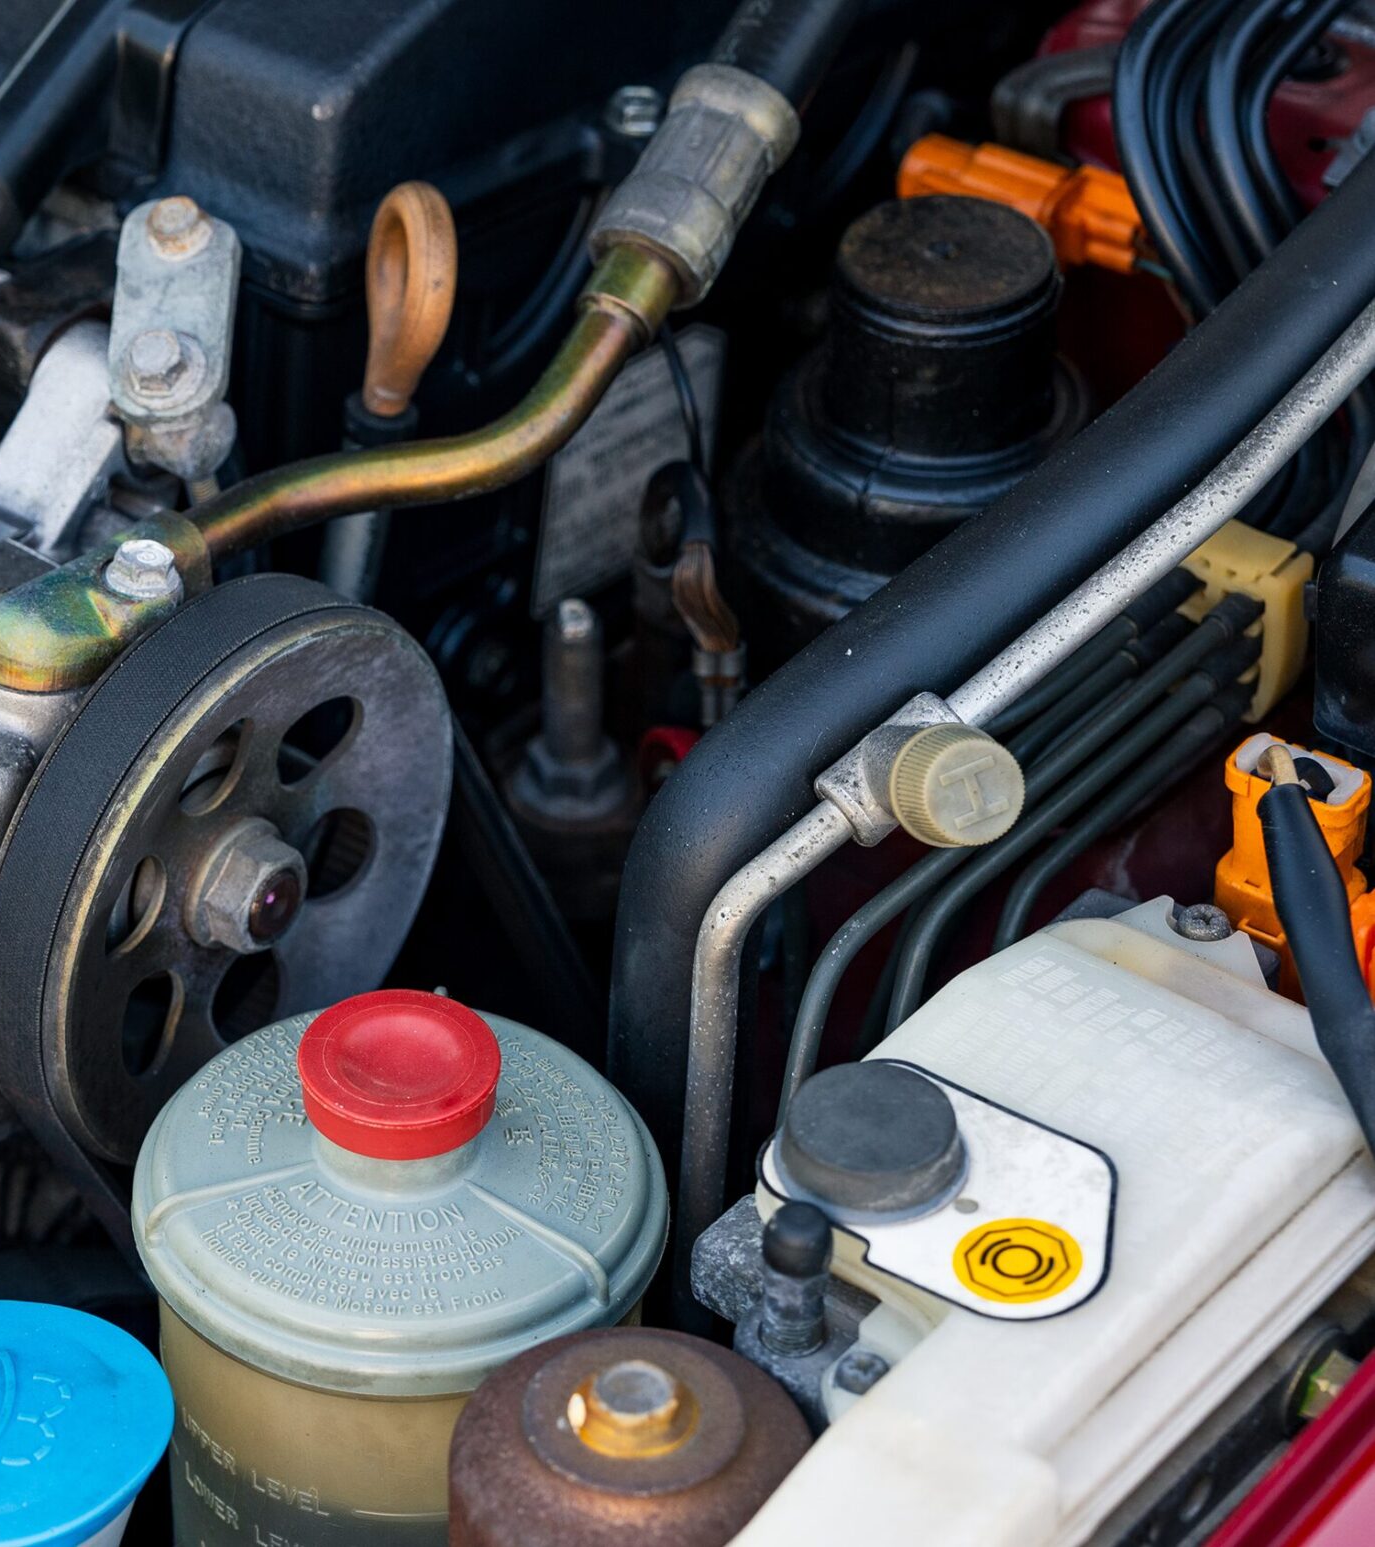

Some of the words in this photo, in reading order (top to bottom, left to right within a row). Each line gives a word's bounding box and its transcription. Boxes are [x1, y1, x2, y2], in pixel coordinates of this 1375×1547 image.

[939, 755, 1010, 830] H
[243, 1192, 283, 1232] liquide
[281, 1226, 302, 1243] de
[302, 1237, 380, 1267] direction
[379, 1249, 461, 1269] assistee
[290, 1179, 466, 1233] ATTENTION
[338, 1233, 455, 1254] uniquement
[455, 1227, 479, 1246] le
[200, 1229, 248, 1271] liquide
[249, 1269, 305, 1299] quand
[308, 1289, 327, 1305] le
[332, 1295, 405, 1315] Moteur
[411, 1300, 443, 1315] est
[216, 1219, 235, 1235] il
[228, 1231, 264, 1260] faut
[264, 1256, 357, 1296] completer
[363, 1287, 412, 1300] avec
[419, 1284, 440, 1299] le
[235, 1211, 281, 1248] Quand
[280, 1244, 299, 1261] le
[305, 1256, 370, 1283] Niveau
[382, 1272, 414, 1284] est
[420, 1266, 467, 1283] trop
[465, 1253, 505, 1274] Bas
[181, 1406, 238, 1476] UPPER
[251, 1469, 331, 1517] LEVEL
[185, 1460, 240, 1531] LOWER
